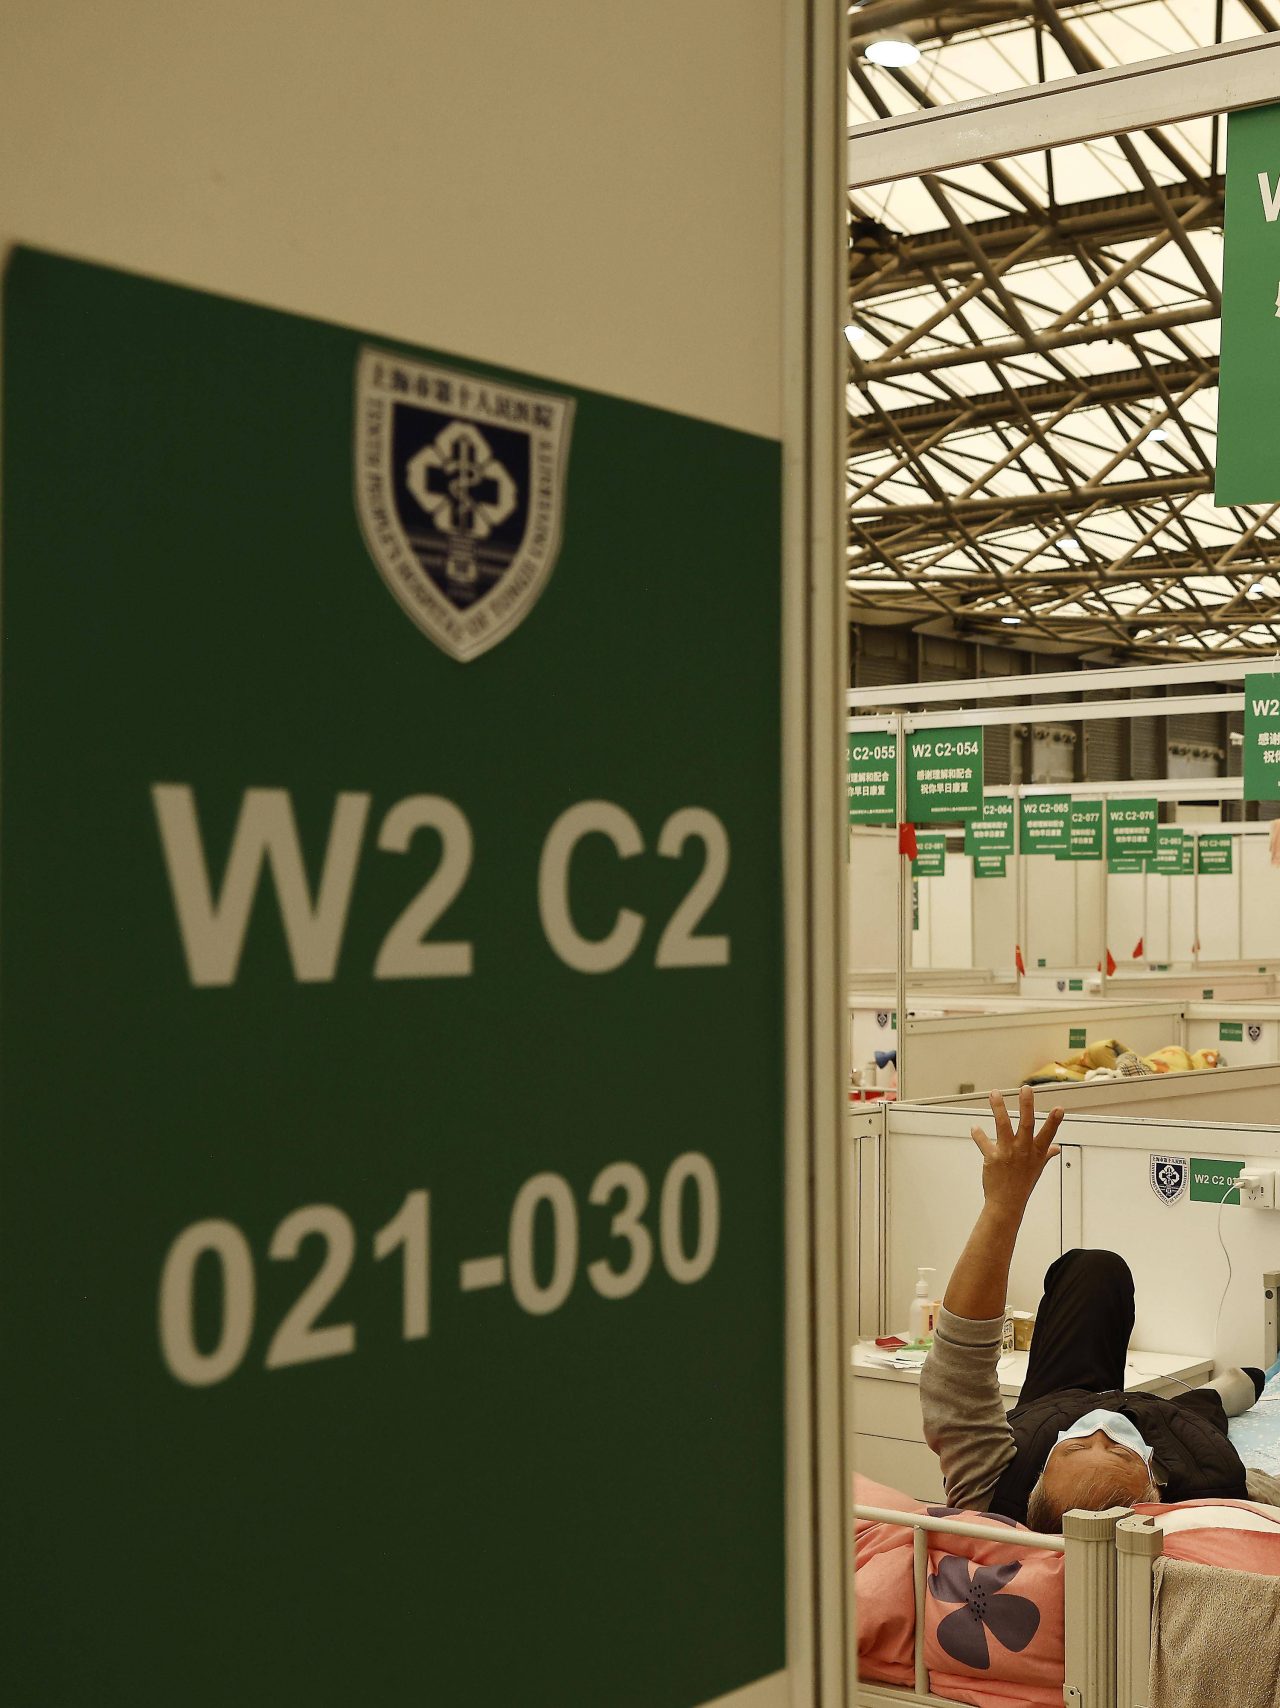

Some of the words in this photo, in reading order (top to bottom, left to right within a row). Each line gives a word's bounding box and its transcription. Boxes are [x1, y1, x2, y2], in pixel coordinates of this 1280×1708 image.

[1252, 699, 1280, 717] W2
[853, 745, 896, 760] C2-055
[912, 744, 932, 758] W2
[935, 741, 979, 757] C2-054
[151, 783, 474, 988] W2
[536, 800, 731, 975] C2
[1194, 1173, 1210, 1184] W2
[1211, 1175, 1225, 1186] C2
[158, 1151, 720, 1388] 021-030
